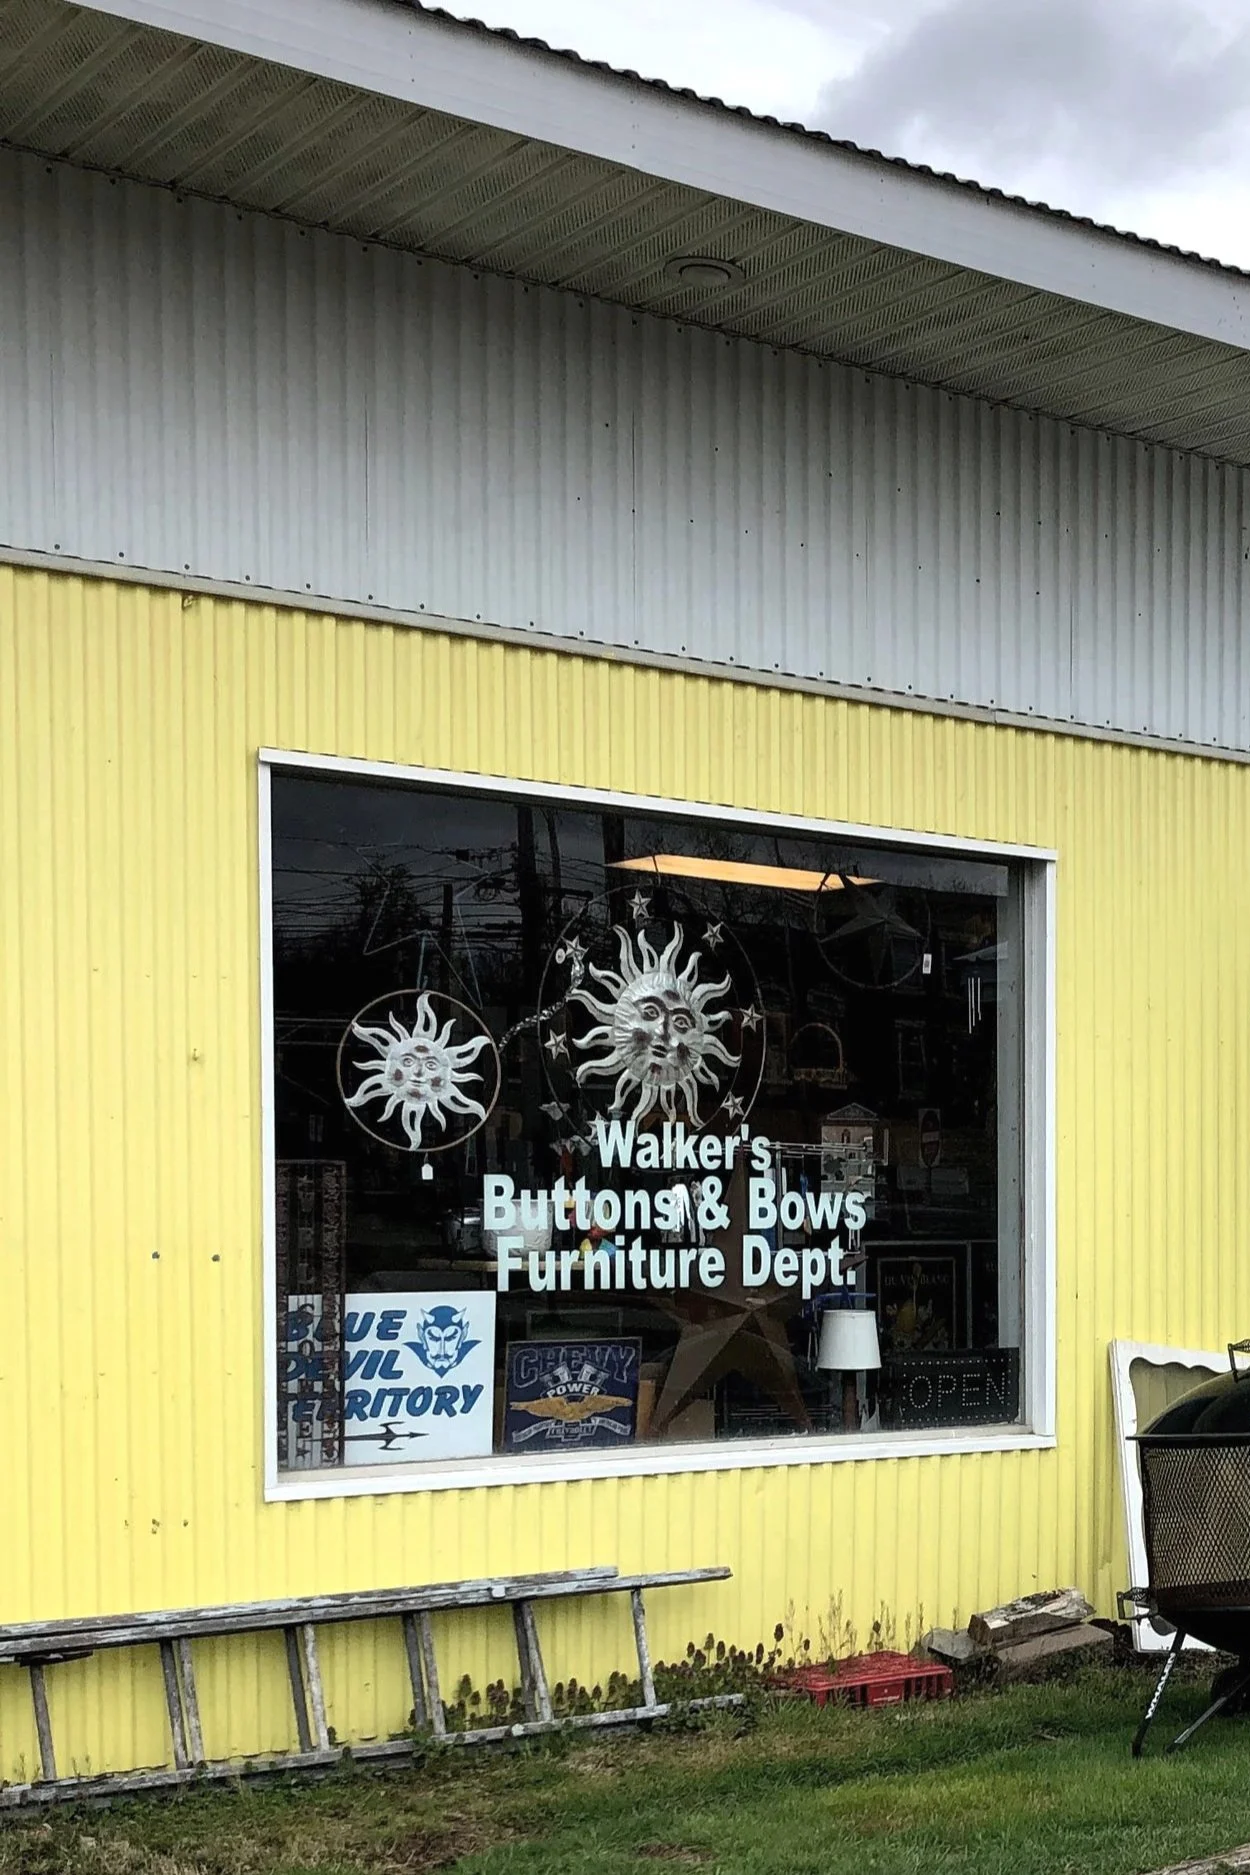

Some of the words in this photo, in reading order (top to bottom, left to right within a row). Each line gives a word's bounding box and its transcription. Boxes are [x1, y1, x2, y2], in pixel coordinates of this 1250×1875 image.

[599, 1119, 772, 1170] Walker's
[483, 1174, 680, 1231] Buttons
[697, 1176, 730, 1231] &
[748, 1177, 867, 1231] Bows
[496, 1235, 725, 1292] Furniture
[742, 1234, 856, 1299] Dept.
[280, 1349, 404, 1382] DEVIL
[513, 1344, 636, 1389] CHEVY
[546, 1383, 601, 1399] POWER
[909, 1372, 1006, 1409] OPEN
[1145, 1652, 1176, 1719] WHALEN
